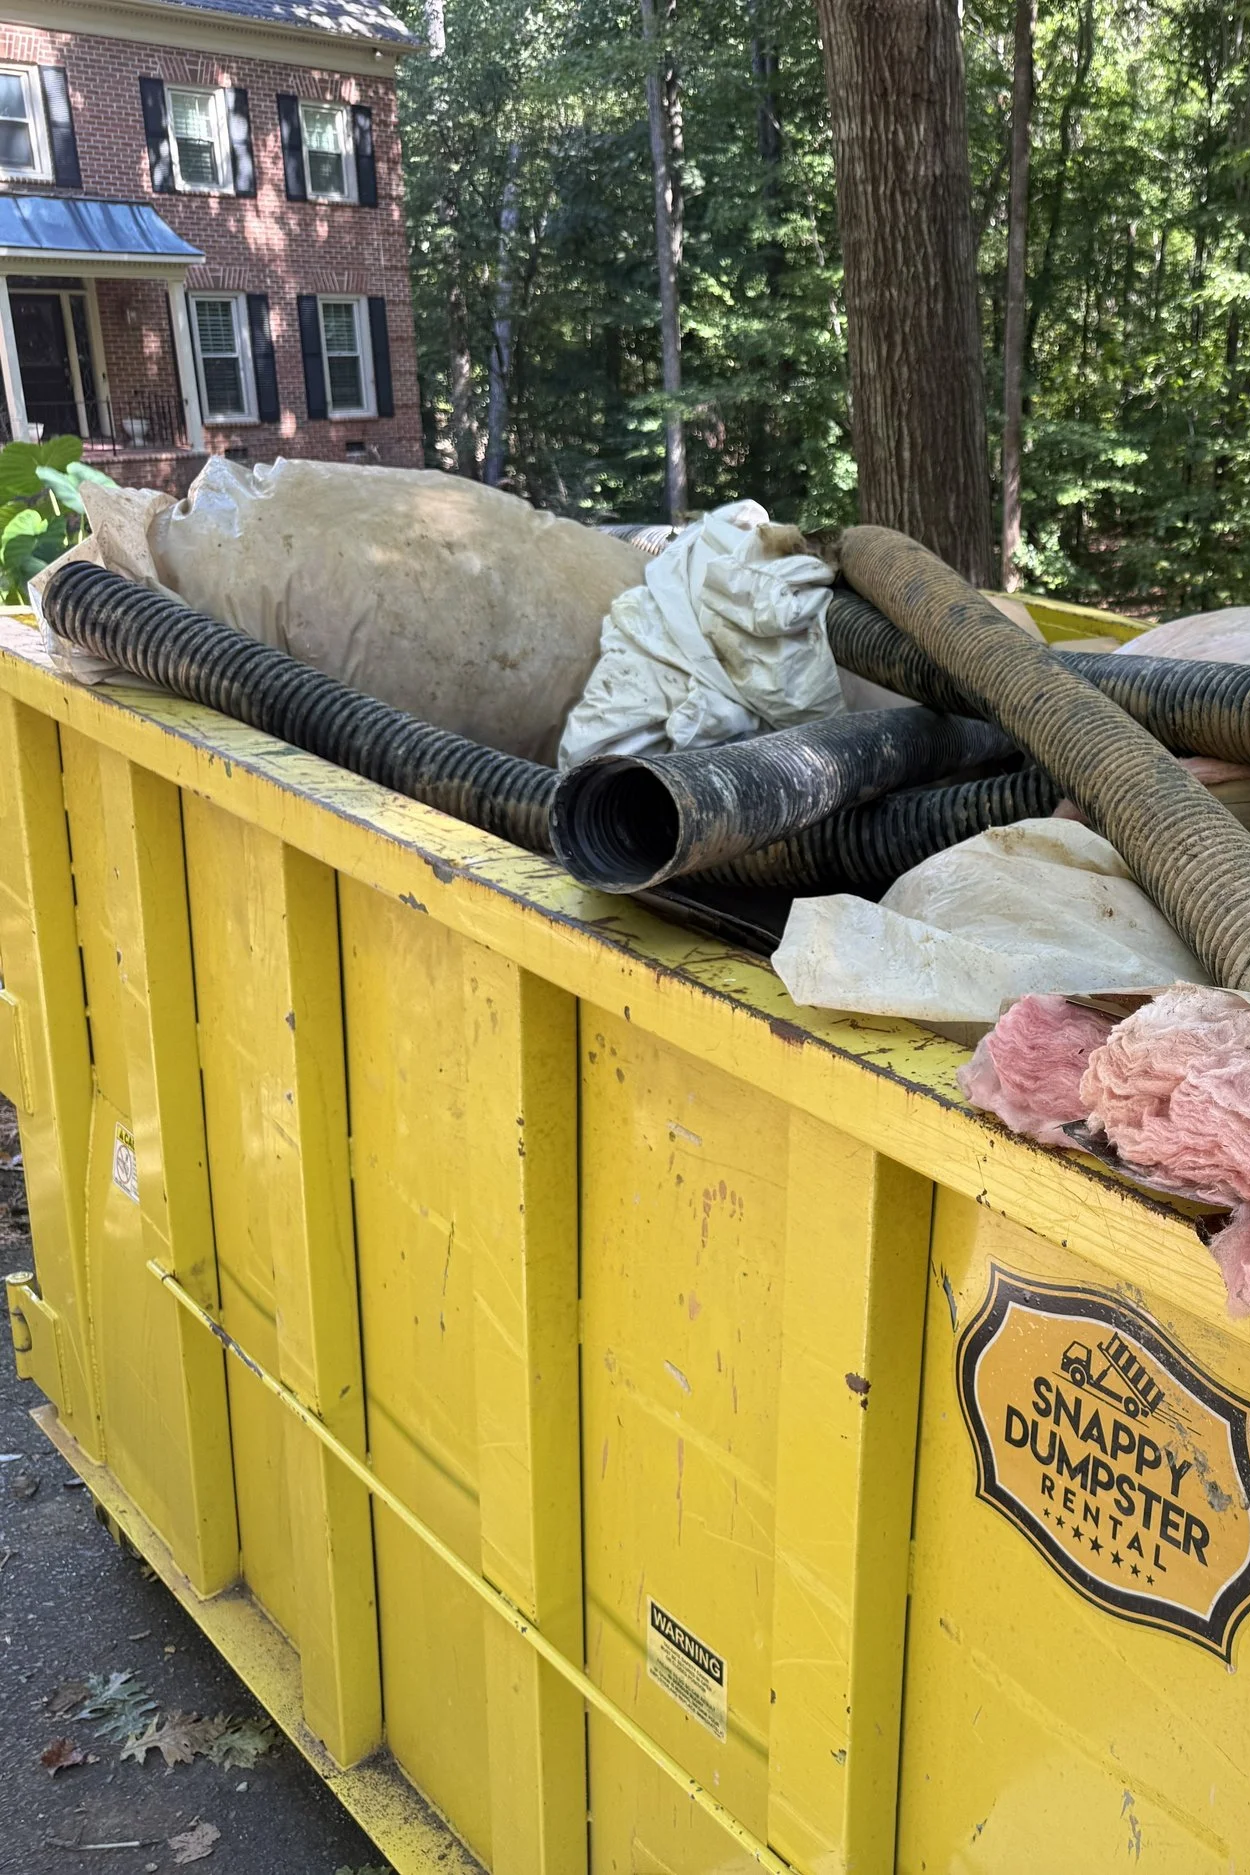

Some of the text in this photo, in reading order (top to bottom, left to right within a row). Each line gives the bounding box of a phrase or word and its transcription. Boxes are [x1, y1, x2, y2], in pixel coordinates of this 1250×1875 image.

[1005, 1404, 1210, 1567] DUMPSTER
[1032, 1376, 1192, 1497] SNAPPY
[1041, 1472, 1167, 1572] RENTAL
[653, 1607, 721, 1678] WARNING
